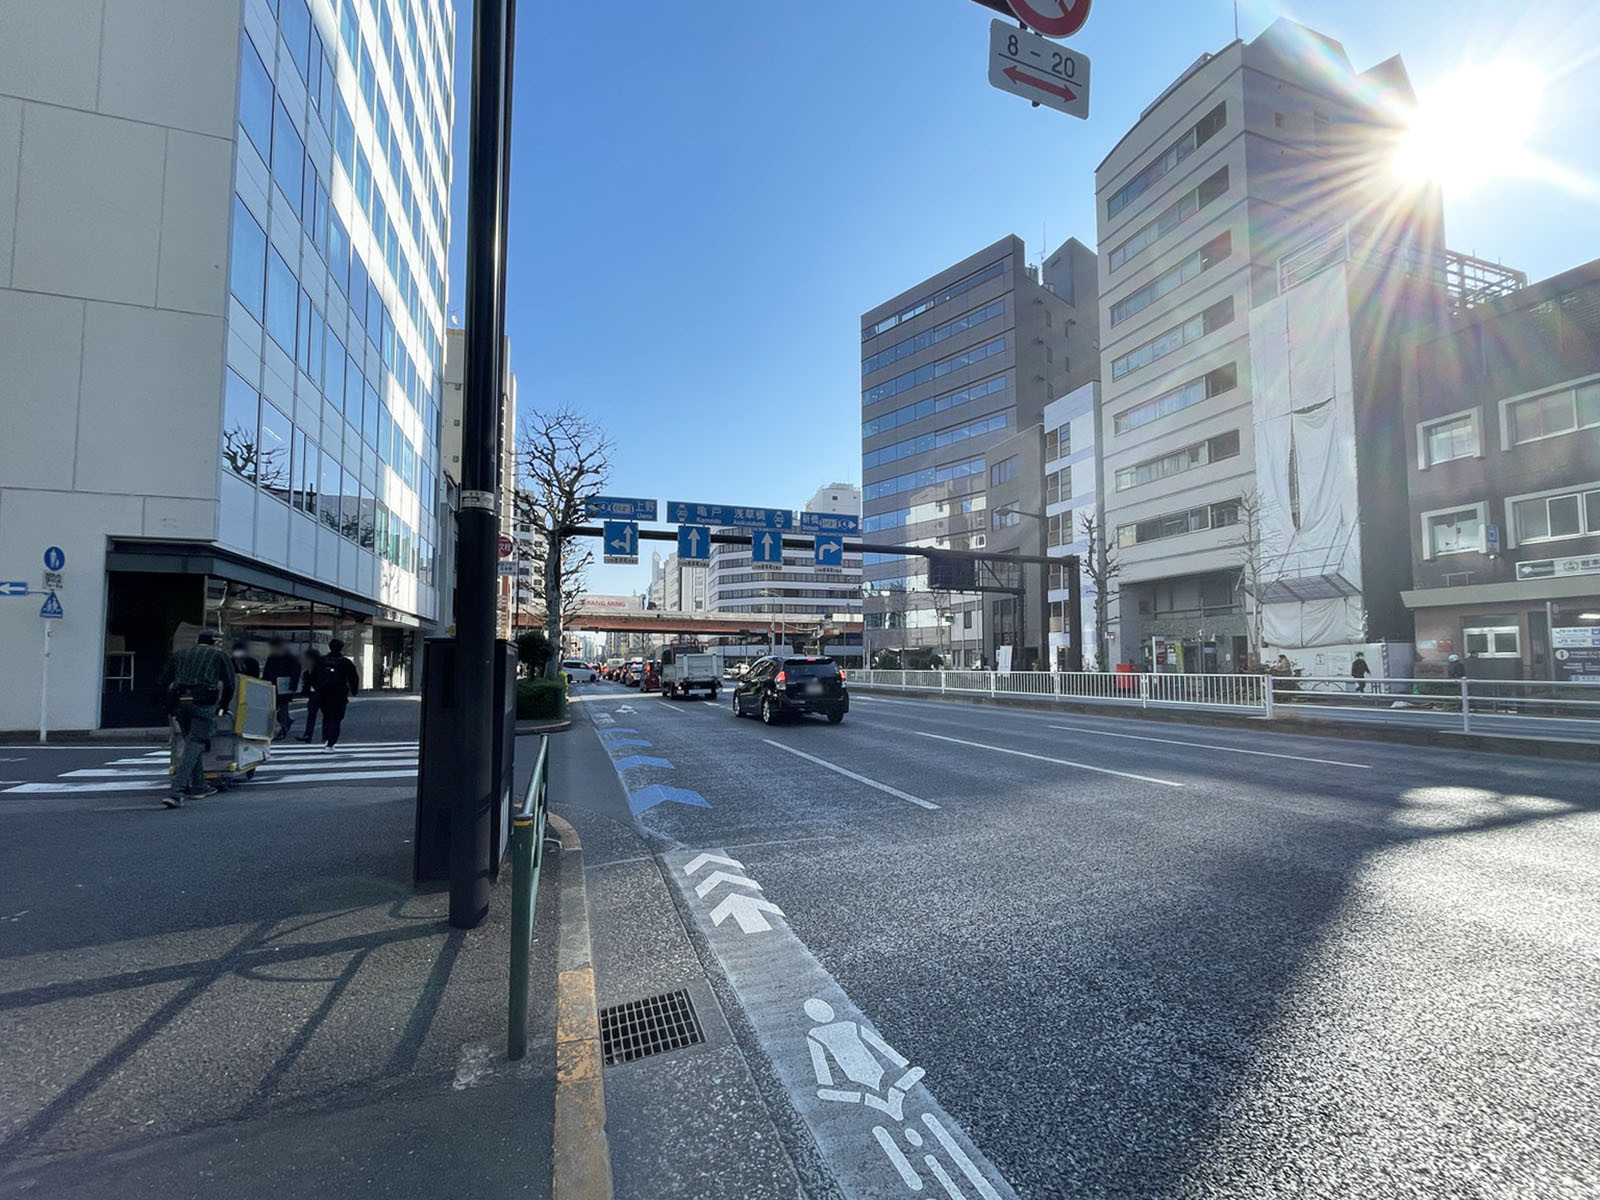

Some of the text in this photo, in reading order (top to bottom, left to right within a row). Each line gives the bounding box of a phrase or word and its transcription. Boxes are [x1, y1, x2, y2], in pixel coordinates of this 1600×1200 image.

[1007, 34, 1019, 57] 8
[1051, 52, 1075, 79] 20
[636, 501, 655, 512] 上野
